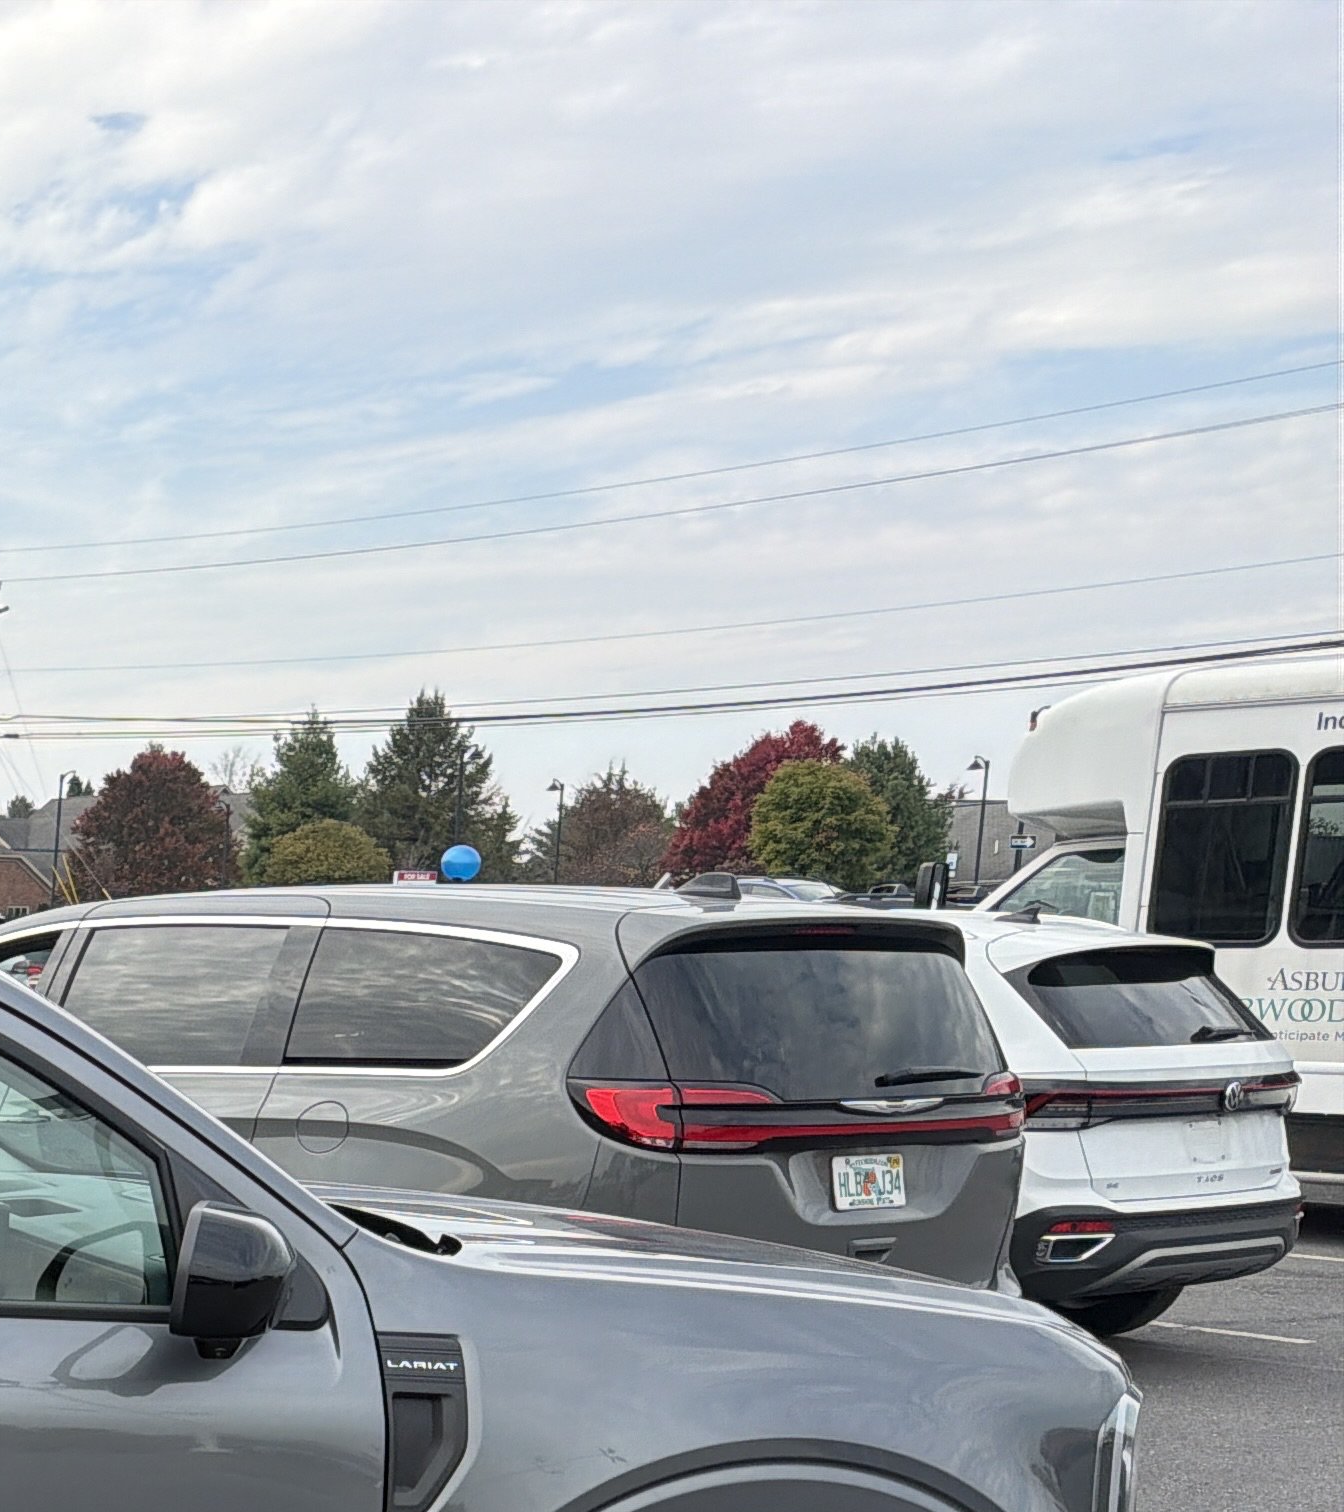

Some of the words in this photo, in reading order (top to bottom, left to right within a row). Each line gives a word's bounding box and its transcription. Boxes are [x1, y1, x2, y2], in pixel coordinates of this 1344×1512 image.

[1267, 967, 1344, 992] ASBU
[1272, 1029, 1330, 1042] ticipate
[838, 1171, 863, 1198] HLB
[386, 1359, 459, 1371] LARIAT
